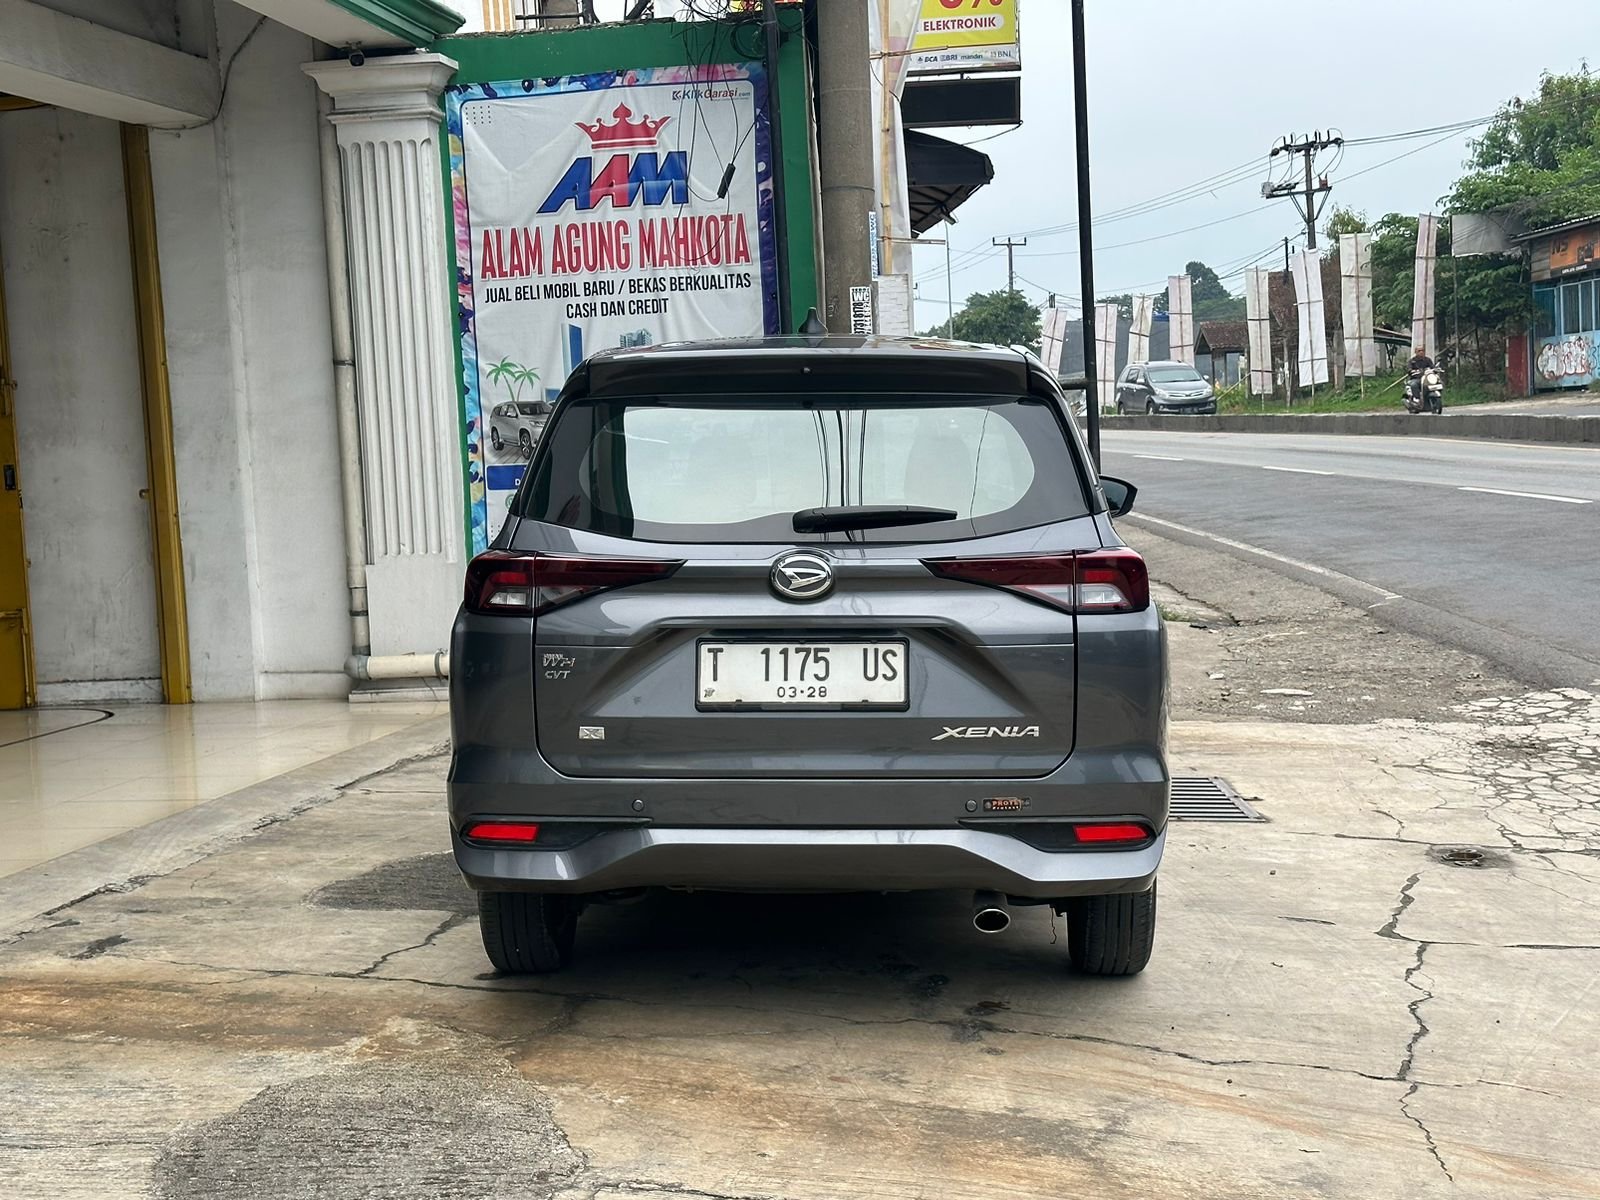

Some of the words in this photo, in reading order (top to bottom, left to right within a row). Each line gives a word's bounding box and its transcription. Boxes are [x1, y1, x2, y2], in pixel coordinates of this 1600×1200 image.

[923, 16, 996, 31] ELEKTRONIK
[536, 150, 689, 214] AAM
[481, 226, 544, 279] ALAM
[551, 219, 631, 275] AGUNG
[638, 213, 751, 269] MAHKOTA
[485, 287, 512, 303] JUAL
[514, 284, 541, 301] BELI
[543, 282, 581, 299] MOBIL
[583, 280, 615, 297] BARU
[618, 279, 626, 294] /
[628, 277, 667, 294] BEKAS
[669, 272, 752, 292] BERKUALITAS
[852, 292, 870, 302] WC
[566, 302, 598, 319] CASH
[600, 300, 626, 317] DAN
[628, 297, 669, 315] CREDIT
[544, 670, 571, 679] CVT
[707, 647, 724, 682] T
[760, 647, 831, 682] 1175
[862, 647, 898, 682] US
[931, 725, 1040, 741] XENIA
